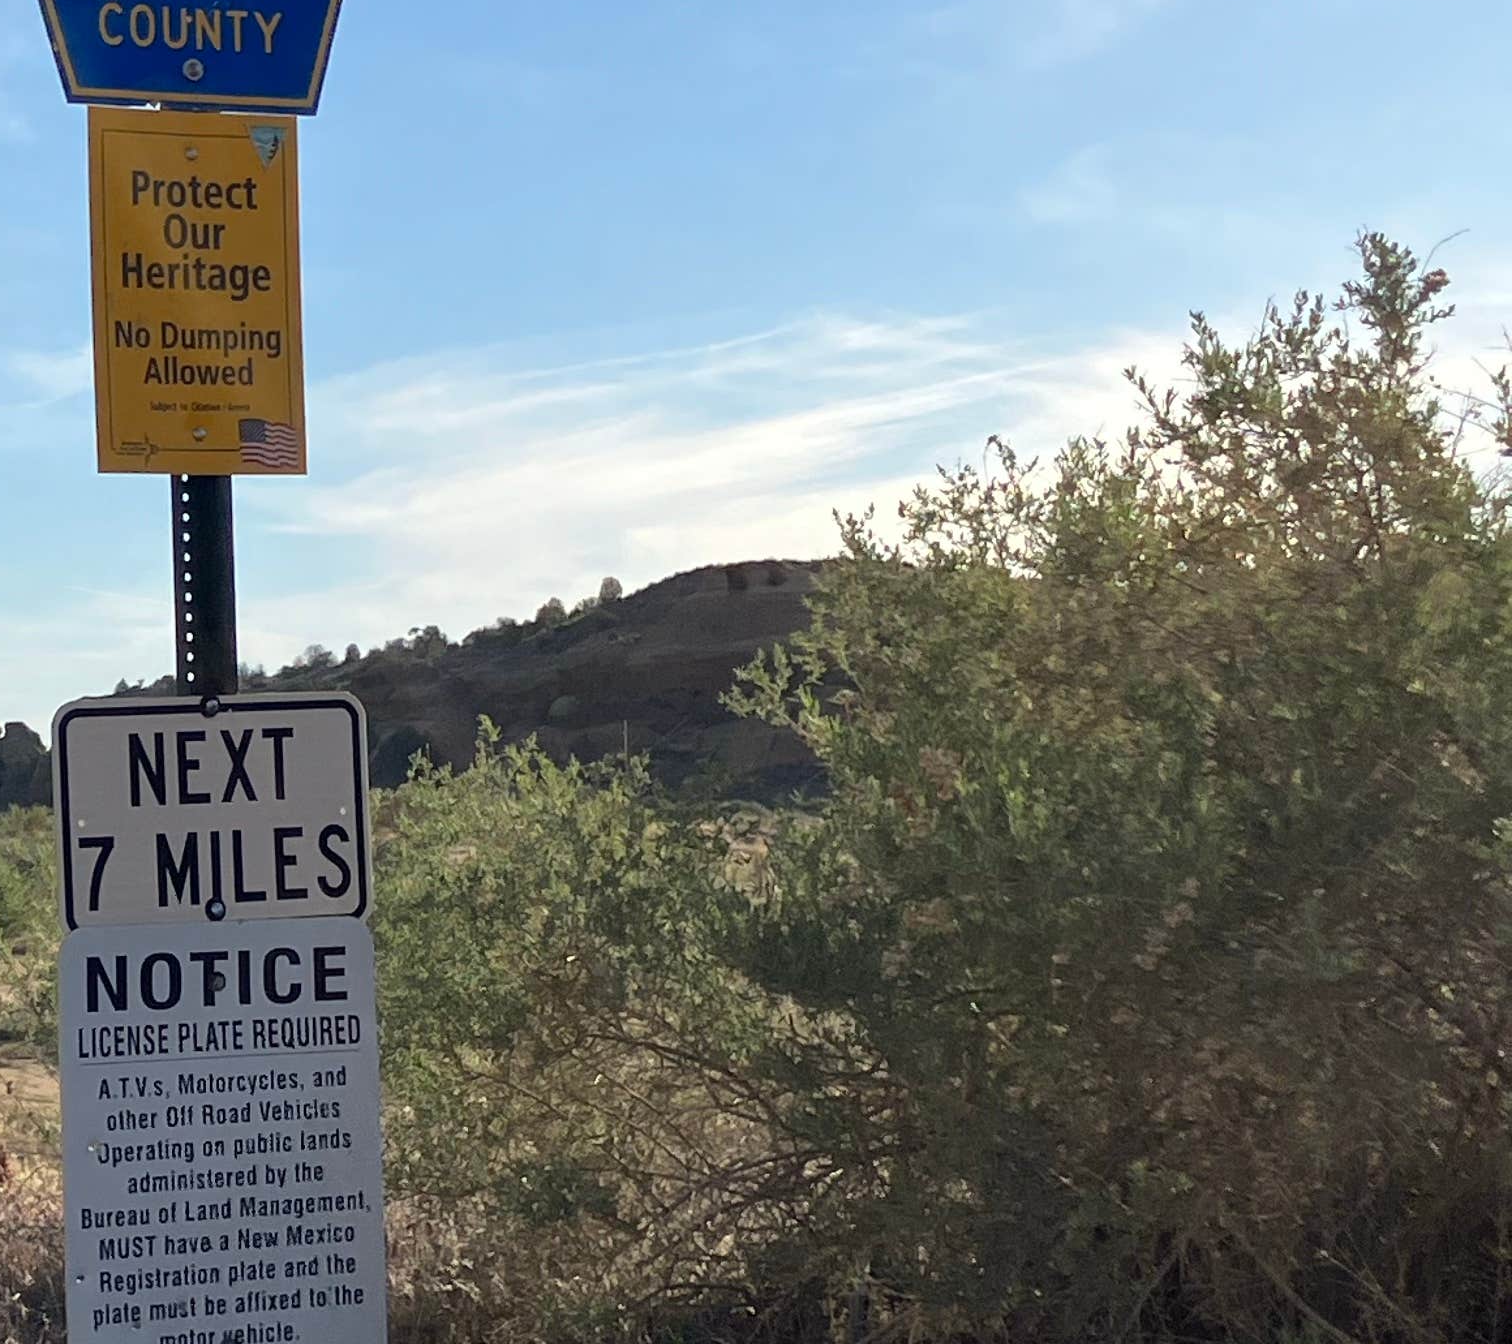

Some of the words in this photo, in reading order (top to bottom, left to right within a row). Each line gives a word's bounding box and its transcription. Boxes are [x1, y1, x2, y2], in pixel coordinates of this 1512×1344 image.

[98, 1, 283, 54] COUNTY
[131, 170, 258, 211] Protect
[163, 213, 226, 251] Our
[120, 252, 272, 302] Heritage
[114, 320, 151, 349] No
[161, 321, 281, 358] Dumping
[144, 357, 254, 386] Allowed
[128, 727, 294, 807] NEXT
[78, 836, 115, 911] 7
[156, 824, 351, 908] MILES
[86, 946, 348, 1013] NOTICE
[78, 1024, 169, 1058] LICENSE
[178, 1020, 244, 1053] PLATE
[252, 1014, 361, 1050] REQUIRED
[178, 1070, 305, 1096] Motorcycles,
[313, 1066, 347, 1088] and
[107, 1110, 158, 1131] other
[166, 1105, 194, 1128] Off
[202, 1103, 251, 1125] Road
[259, 1099, 341, 1122] Vehicles
[97, 1141, 195, 1167] Operating
[203, 1140, 226, 1158] on
[233, 1131, 292, 1158] public
[300, 1128, 353, 1151] lands
[127, 1166, 257, 1195] administered
[265, 1164, 286, 1187] by
[295, 1162, 324, 1183] the
[81, 1204, 151, 1229] Bureau
[158, 1202, 177, 1224] of
[185, 1198, 232, 1222] Land
[239, 1191, 372, 1218] Management,
[99, 1235, 157, 1260] MUST
[164, 1232, 213, 1255] have
[220, 1235, 230, 1252] a
[237, 1228, 279, 1250] New
[286, 1223, 356, 1247] Mexico
[100, 1264, 221, 1295] Registration
[228, 1258, 277, 1286] plate
[284, 1257, 319, 1278] and
[326, 1254, 357, 1275] the
[92, 1303, 142, 1331] plate
[149, 1300, 197, 1321] must
[205, 1295, 227, 1316] be
[235, 1290, 302, 1312] affixed
[309, 1288, 327, 1306] to
[334, 1285, 365, 1306] the
